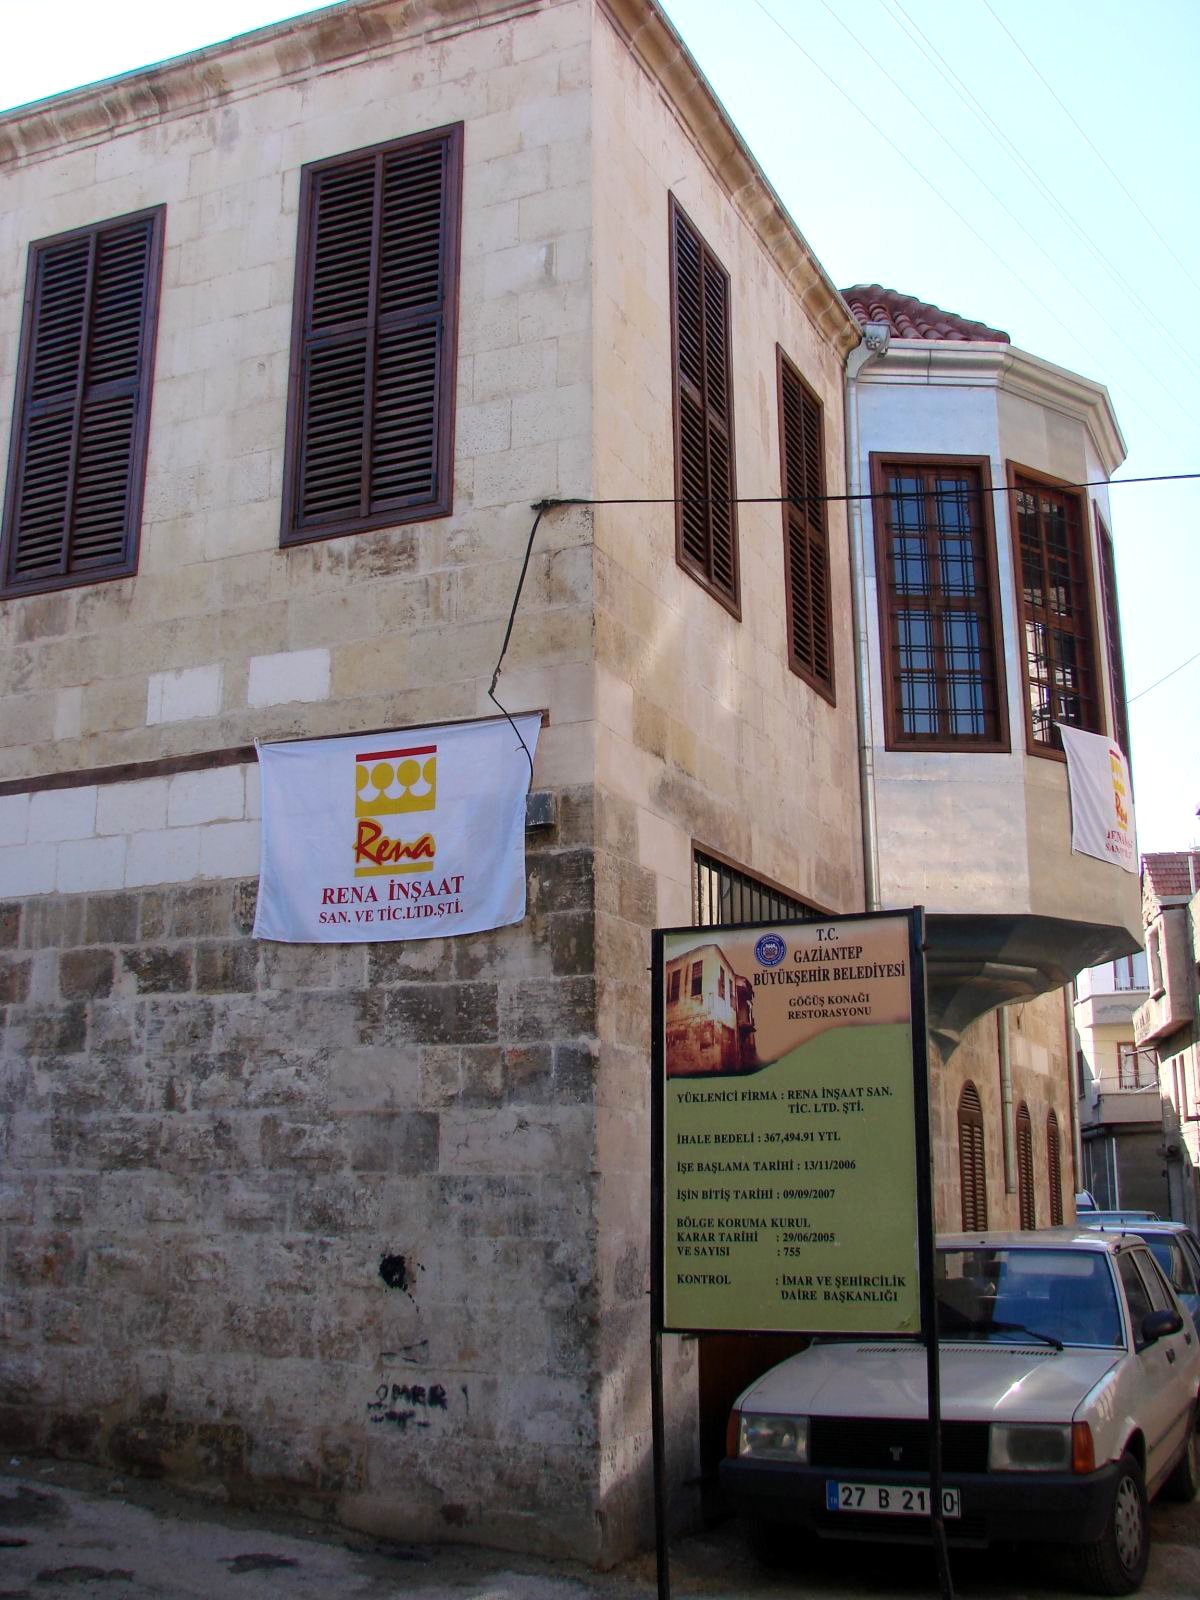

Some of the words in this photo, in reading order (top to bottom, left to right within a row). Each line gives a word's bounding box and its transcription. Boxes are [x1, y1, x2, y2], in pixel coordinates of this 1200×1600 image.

[354, 818, 435, 866] Rena
[321, 886, 378, 904] RENA
[388, 876, 464, 902] İNŞAAT
[319, 910, 350, 924] SAN.
[356, 910, 374, 922] VE
[378, 899, 463, 921] TİC.LTD.ŞTİ.
[816, 928, 839, 941] T.C.
[794, 946, 862, 963] GAZİANTEP
[754, 965, 831, 986] BÜYÜKŞEHİR
[834, 960, 905, 980] BELEDİYESİ
[789, 994, 825, 1007] GÖĞÜŞ
[828, 993, 869, 1005] KONAĞI
[788, 1007, 871, 1020] RESTORASYONU
[677, 1090, 737, 1103] YÜKLENİCİ
[741, 1089, 776, 1101] FİRMA
[788, 1089, 818, 1100] RENA
[823, 1087, 864, 1100] İNŞAAT
[866, 1086, 892, 1096] SAN.
[788, 1103, 811, 1114] TİC.
[814, 1103, 839, 1113] LTD.
[842, 1102, 864, 1114] ŞTİ.
[677, 1133, 710, 1144] İHALE
[714, 1132, 754, 1143] BEDELİ
[764, 1133, 814, 1144] 367,494.91
[818, 1132, 840, 1141] YTL
[677, 1162, 694, 1173] İŞE
[697, 1161, 749, 1173] BAŞLAMA
[753, 1159, 793, 1171] TARİHİ
[804, 1160, 855, 1170] 13/11/2006
[677, 1189, 698, 1201] İŞİN
[702, 1189, 730, 1201] BİTİŞ
[734, 1188, 773, 1199] TARİHİ
[783, 1190, 835, 1199] 09/09/2007
[677, 1216, 714, 1227] BÖLGE
[717, 1219, 767, 1227] KORUMA
[771, 1219, 810, 1228] KURUL
[677, 1233, 715, 1242] KARAR
[719, 1231, 758, 1242] TARİHİ
[783, 1233, 835, 1242] 29/06/2005
[677, 1247, 691, 1256] VE
[694, 1247, 730, 1256] SAYISI
[784, 1247, 800, 1257] 755
[677, 1275, 731, 1284] KONTROL
[782, 1275, 813, 1286] İMAR
[817, 1276, 831, 1286] VE
[835, 1275, 906, 1288] ŞEHİRCİLİK
[781, 1289, 816, 1300] DAİRE
[824, 1290, 898, 1302] BAŞKANLIĞI
[841, 1486, 865, 1507] 27
[878, 1488, 890, 1508] B
[902, 1490, 954, 1512] 210
